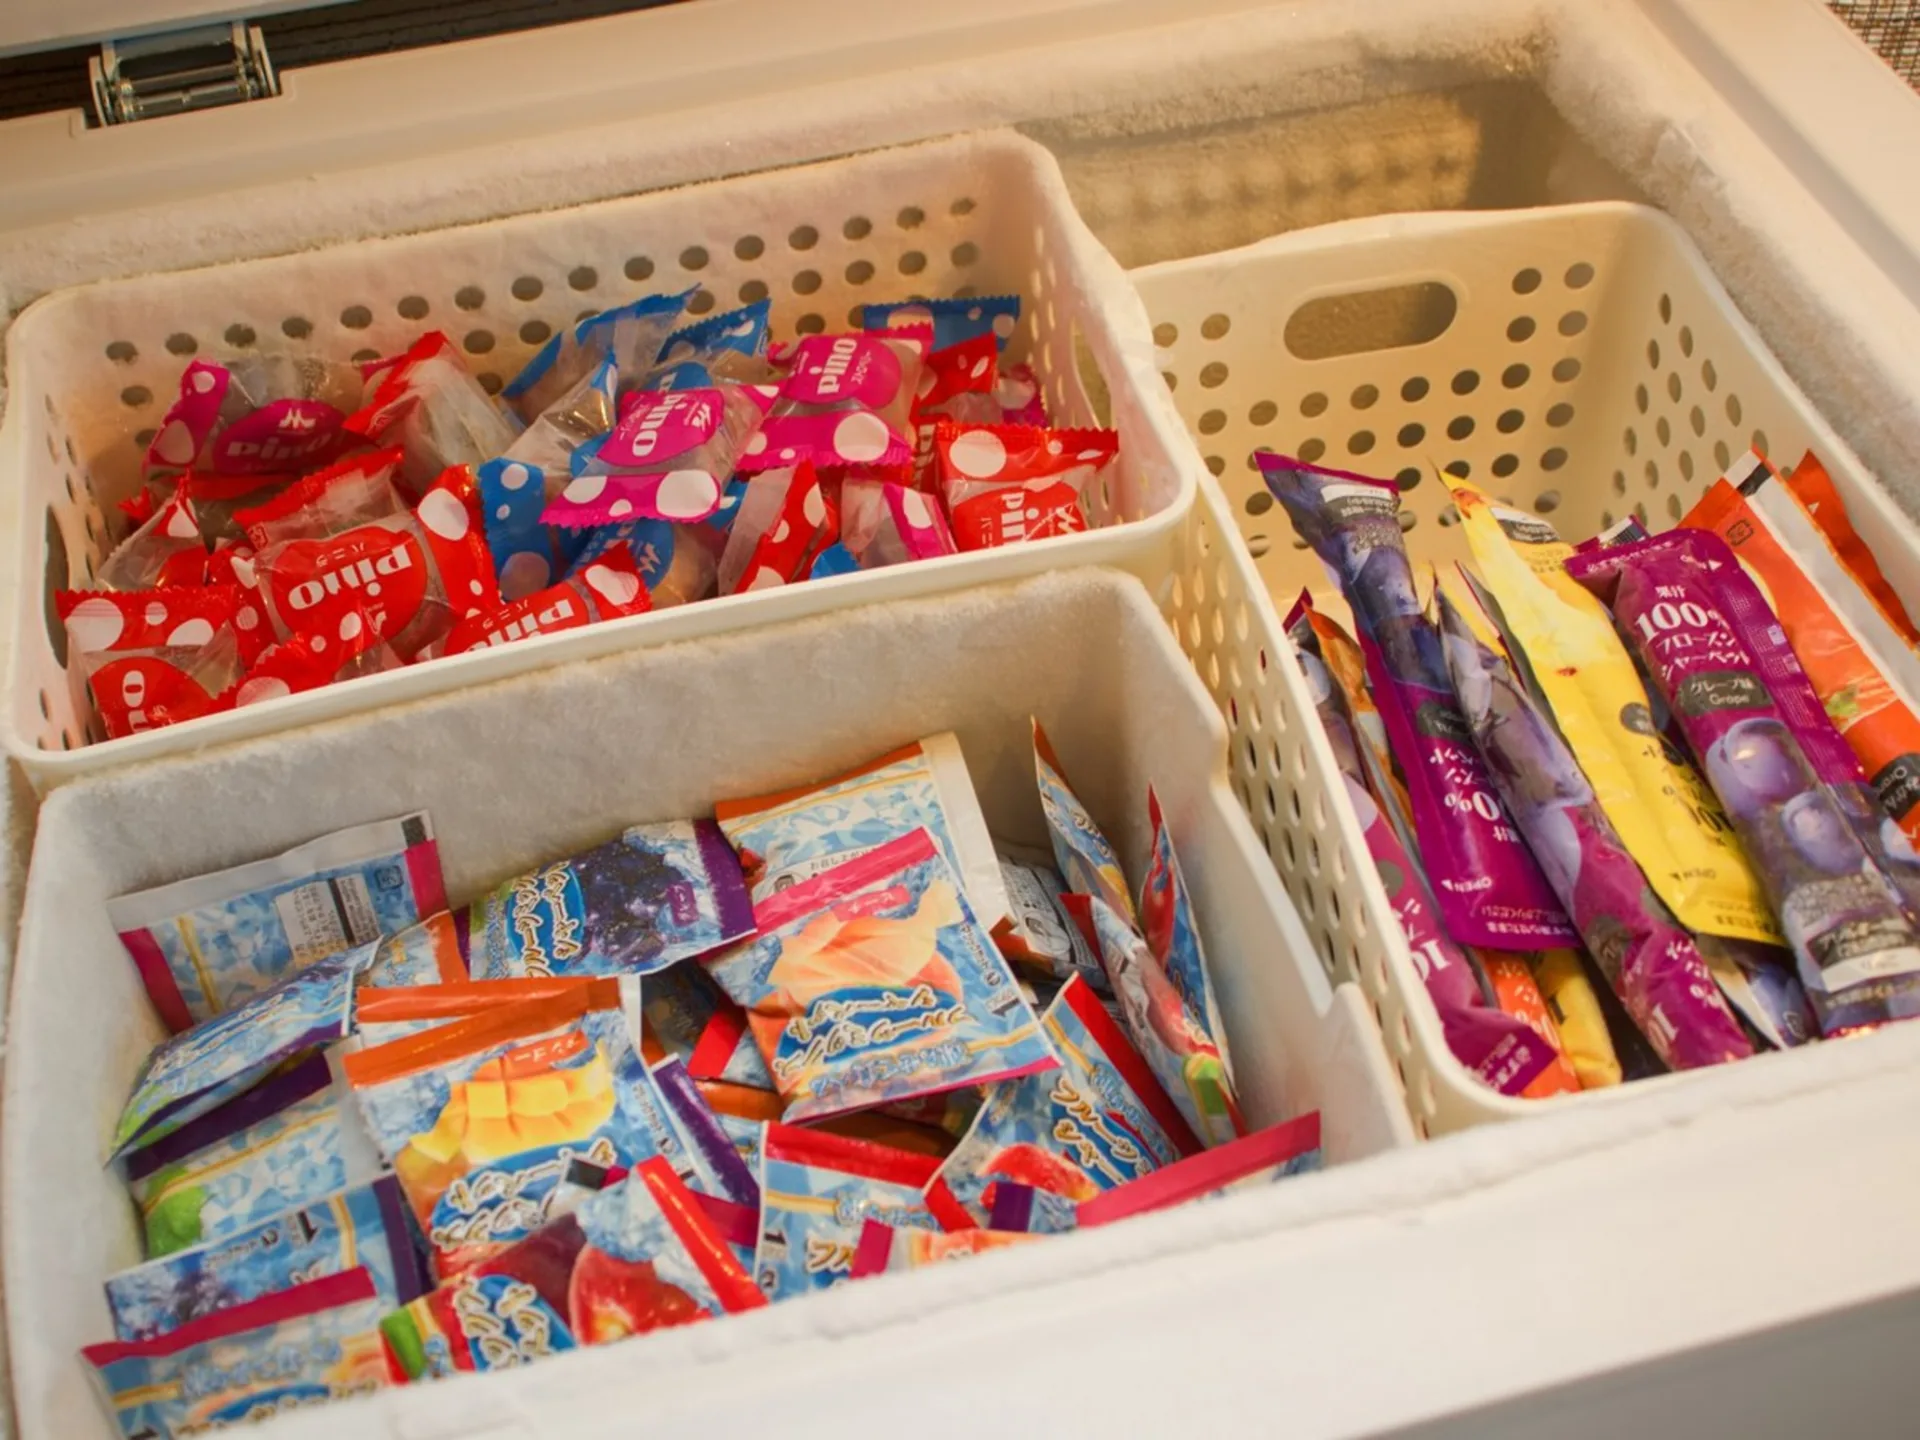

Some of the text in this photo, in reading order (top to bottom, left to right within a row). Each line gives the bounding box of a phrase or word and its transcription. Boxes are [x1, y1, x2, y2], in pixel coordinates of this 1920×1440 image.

[817, 338, 857, 395] pino
[631, 391, 689, 457] pino
[226, 432, 331, 460] pino
[316, 541, 365, 568] バニラ
[288, 543, 413, 611] pino
[1655, 584, 1685, 600] 果汁
[1655, 631, 1736, 652] フローズン
[1660, 650, 1749, 681] シャーベット
[1708, 692, 1750, 705] Grape
[1455, 876, 1493, 892] OPEN
